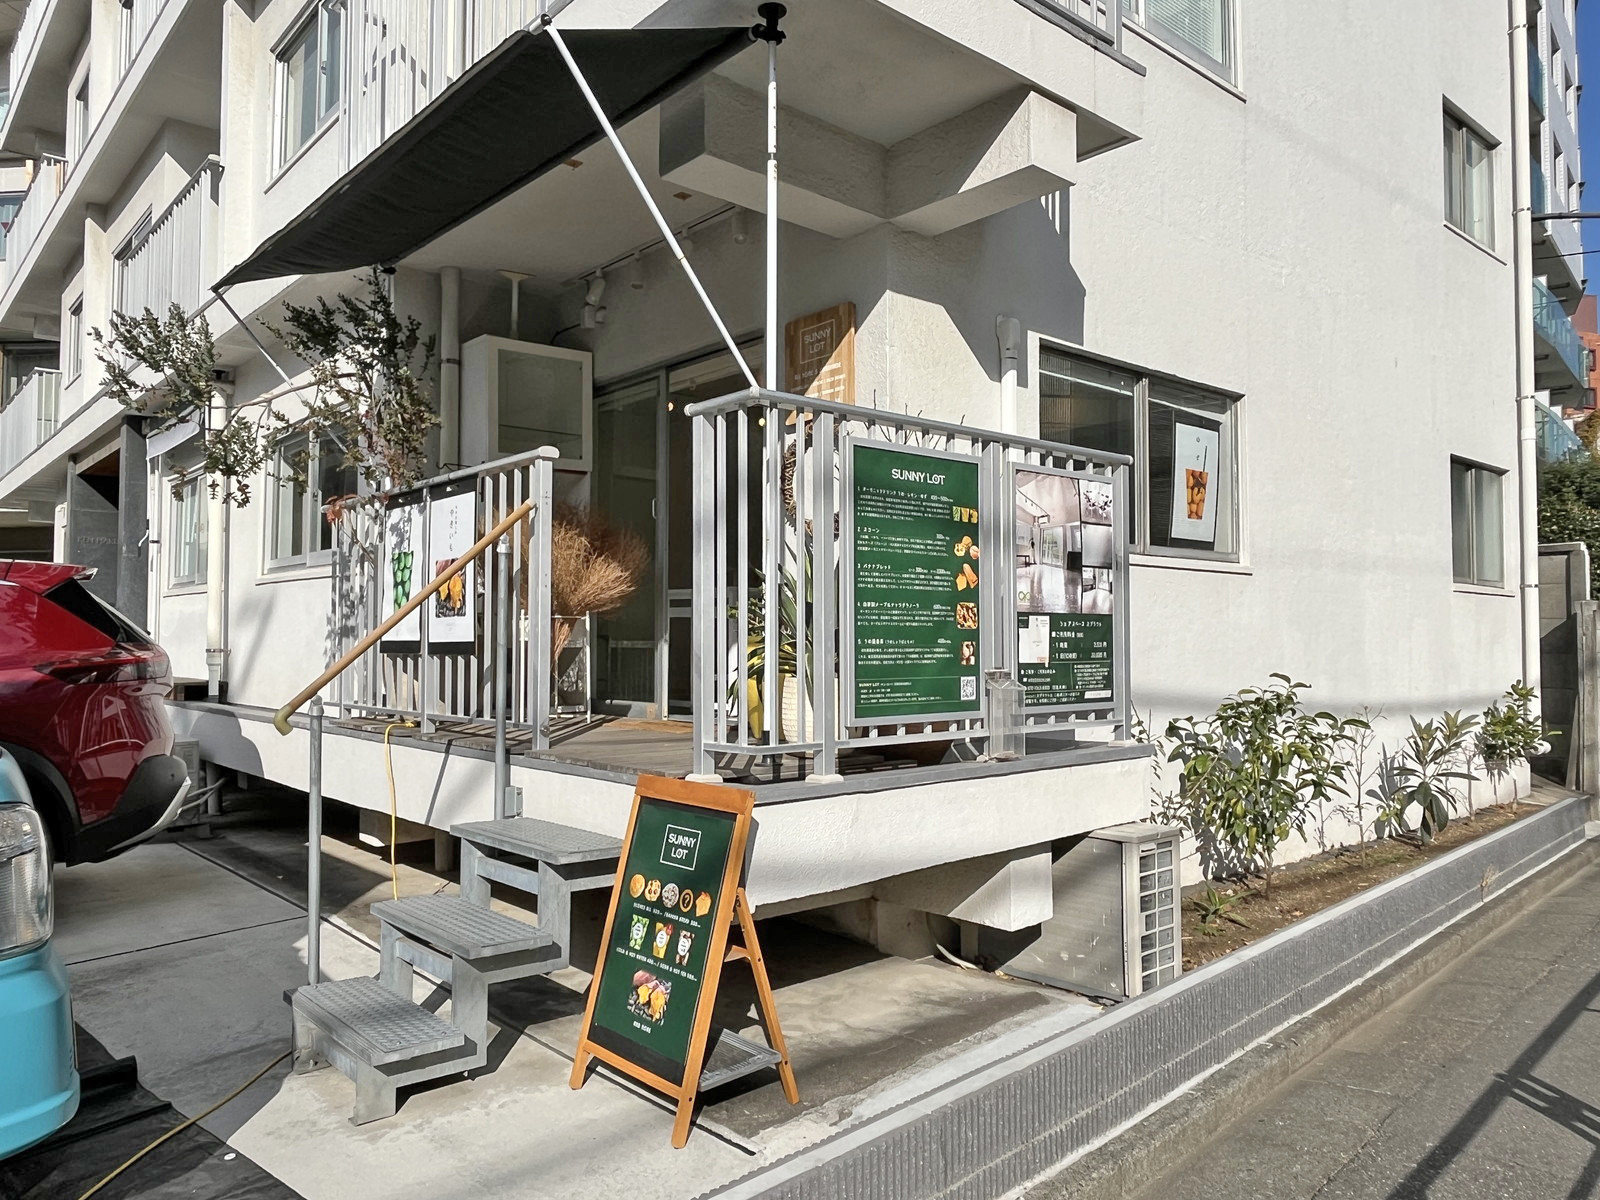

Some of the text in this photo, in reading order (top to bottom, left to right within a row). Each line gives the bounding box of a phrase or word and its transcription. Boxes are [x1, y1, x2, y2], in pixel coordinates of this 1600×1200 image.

[804, 327, 831, 344] SUNNY
[809, 341, 825, 354] LOT
[891, 468, 946, 485] SUNNY LOT
[668, 833, 697, 848] SUNNY
[671, 847, 688, 860] LOT
